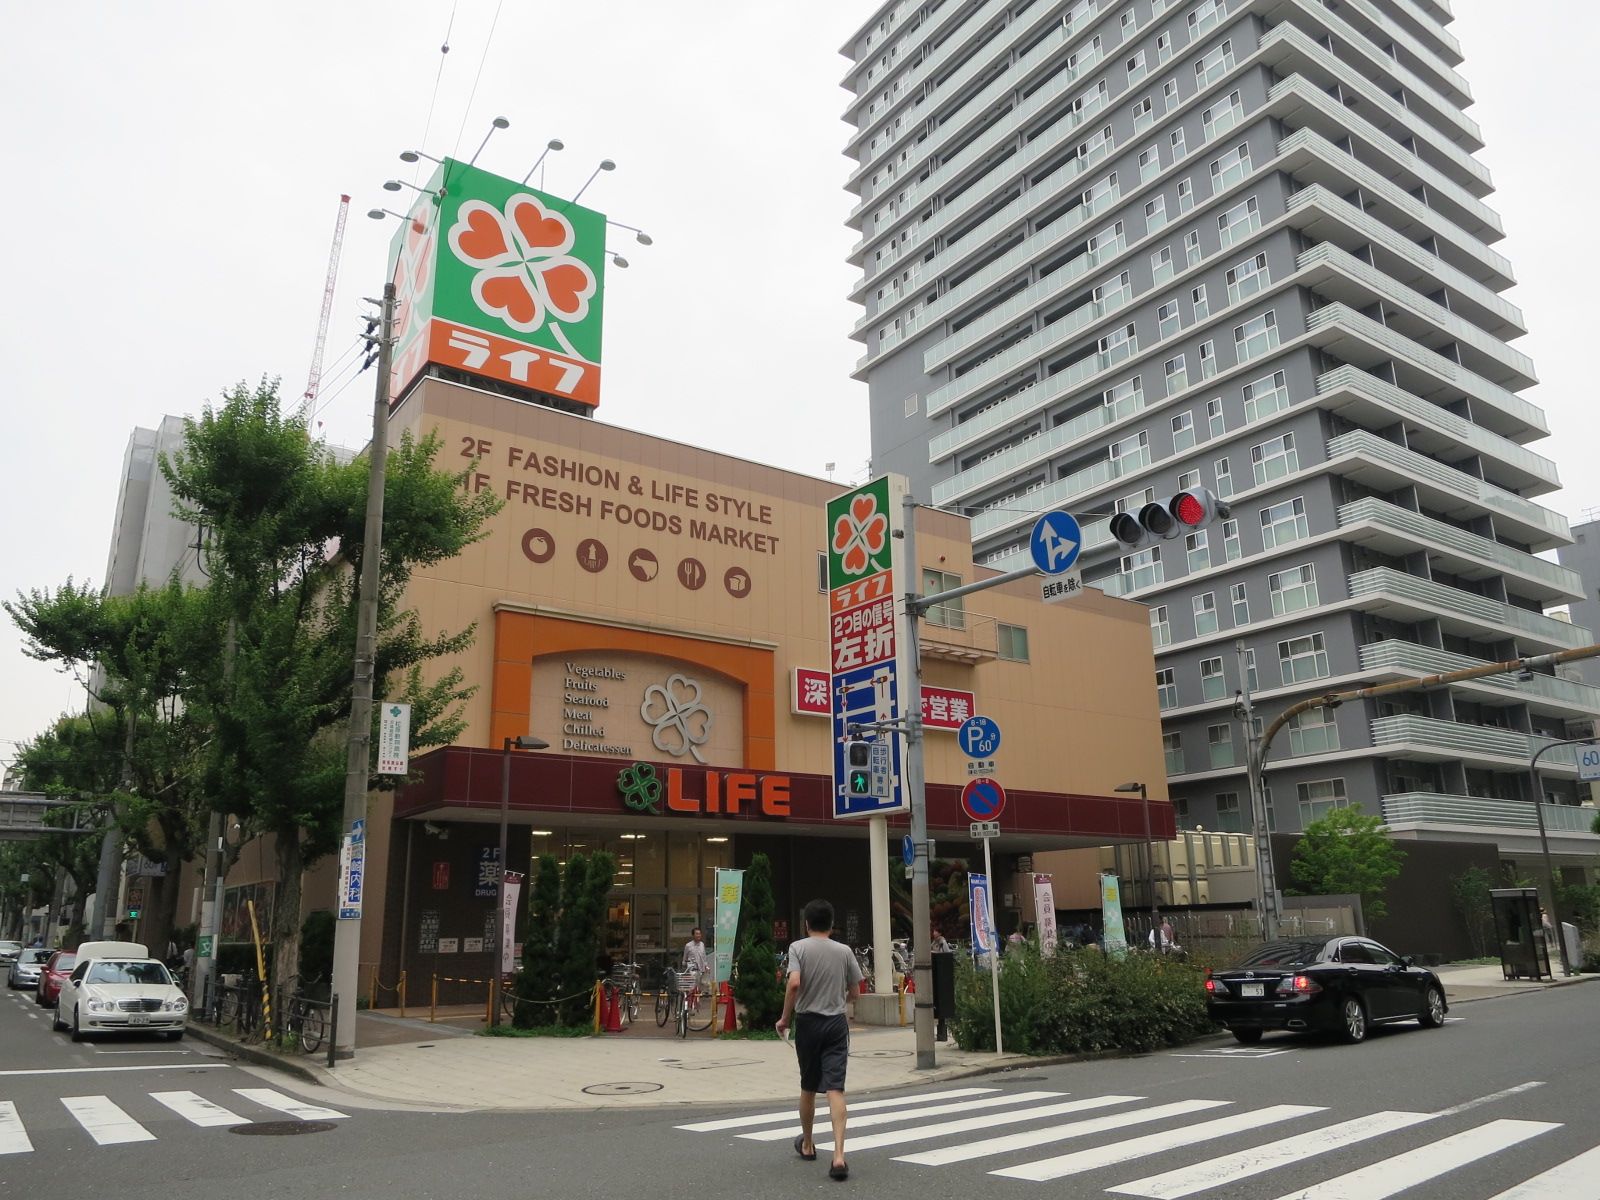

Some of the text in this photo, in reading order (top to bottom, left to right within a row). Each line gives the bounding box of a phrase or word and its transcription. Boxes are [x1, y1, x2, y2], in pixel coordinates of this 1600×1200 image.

[449, 329, 585, 394] ライフ
[460, 436, 773, 525] 2F FASHION & LIFE STYLE
[506, 479, 592, 517] FRESH
[600, 500, 682, 535] FOODS
[689, 519, 780, 555] MARKET
[836, 574, 888, 608] ライフ
[1042, 577, 1081, 599] 自転車を除く
[834, 600, 894, 638] 2つ目の信号
[834, 623, 894, 670] 左折
[566, 662, 628, 681] Vegetables
[564, 677, 599, 692] Fruits
[564, 692, 610, 709] Seafood
[563, 707, 594, 722] Meat
[563, 722, 606, 738] Chilled
[967, 727, 984, 752] P
[563, 737, 634, 757] Delicatessen
[979, 739, 992, 752] 60
[667, 767, 791, 817] LIFE
[482, 847, 500, 858] 2F
